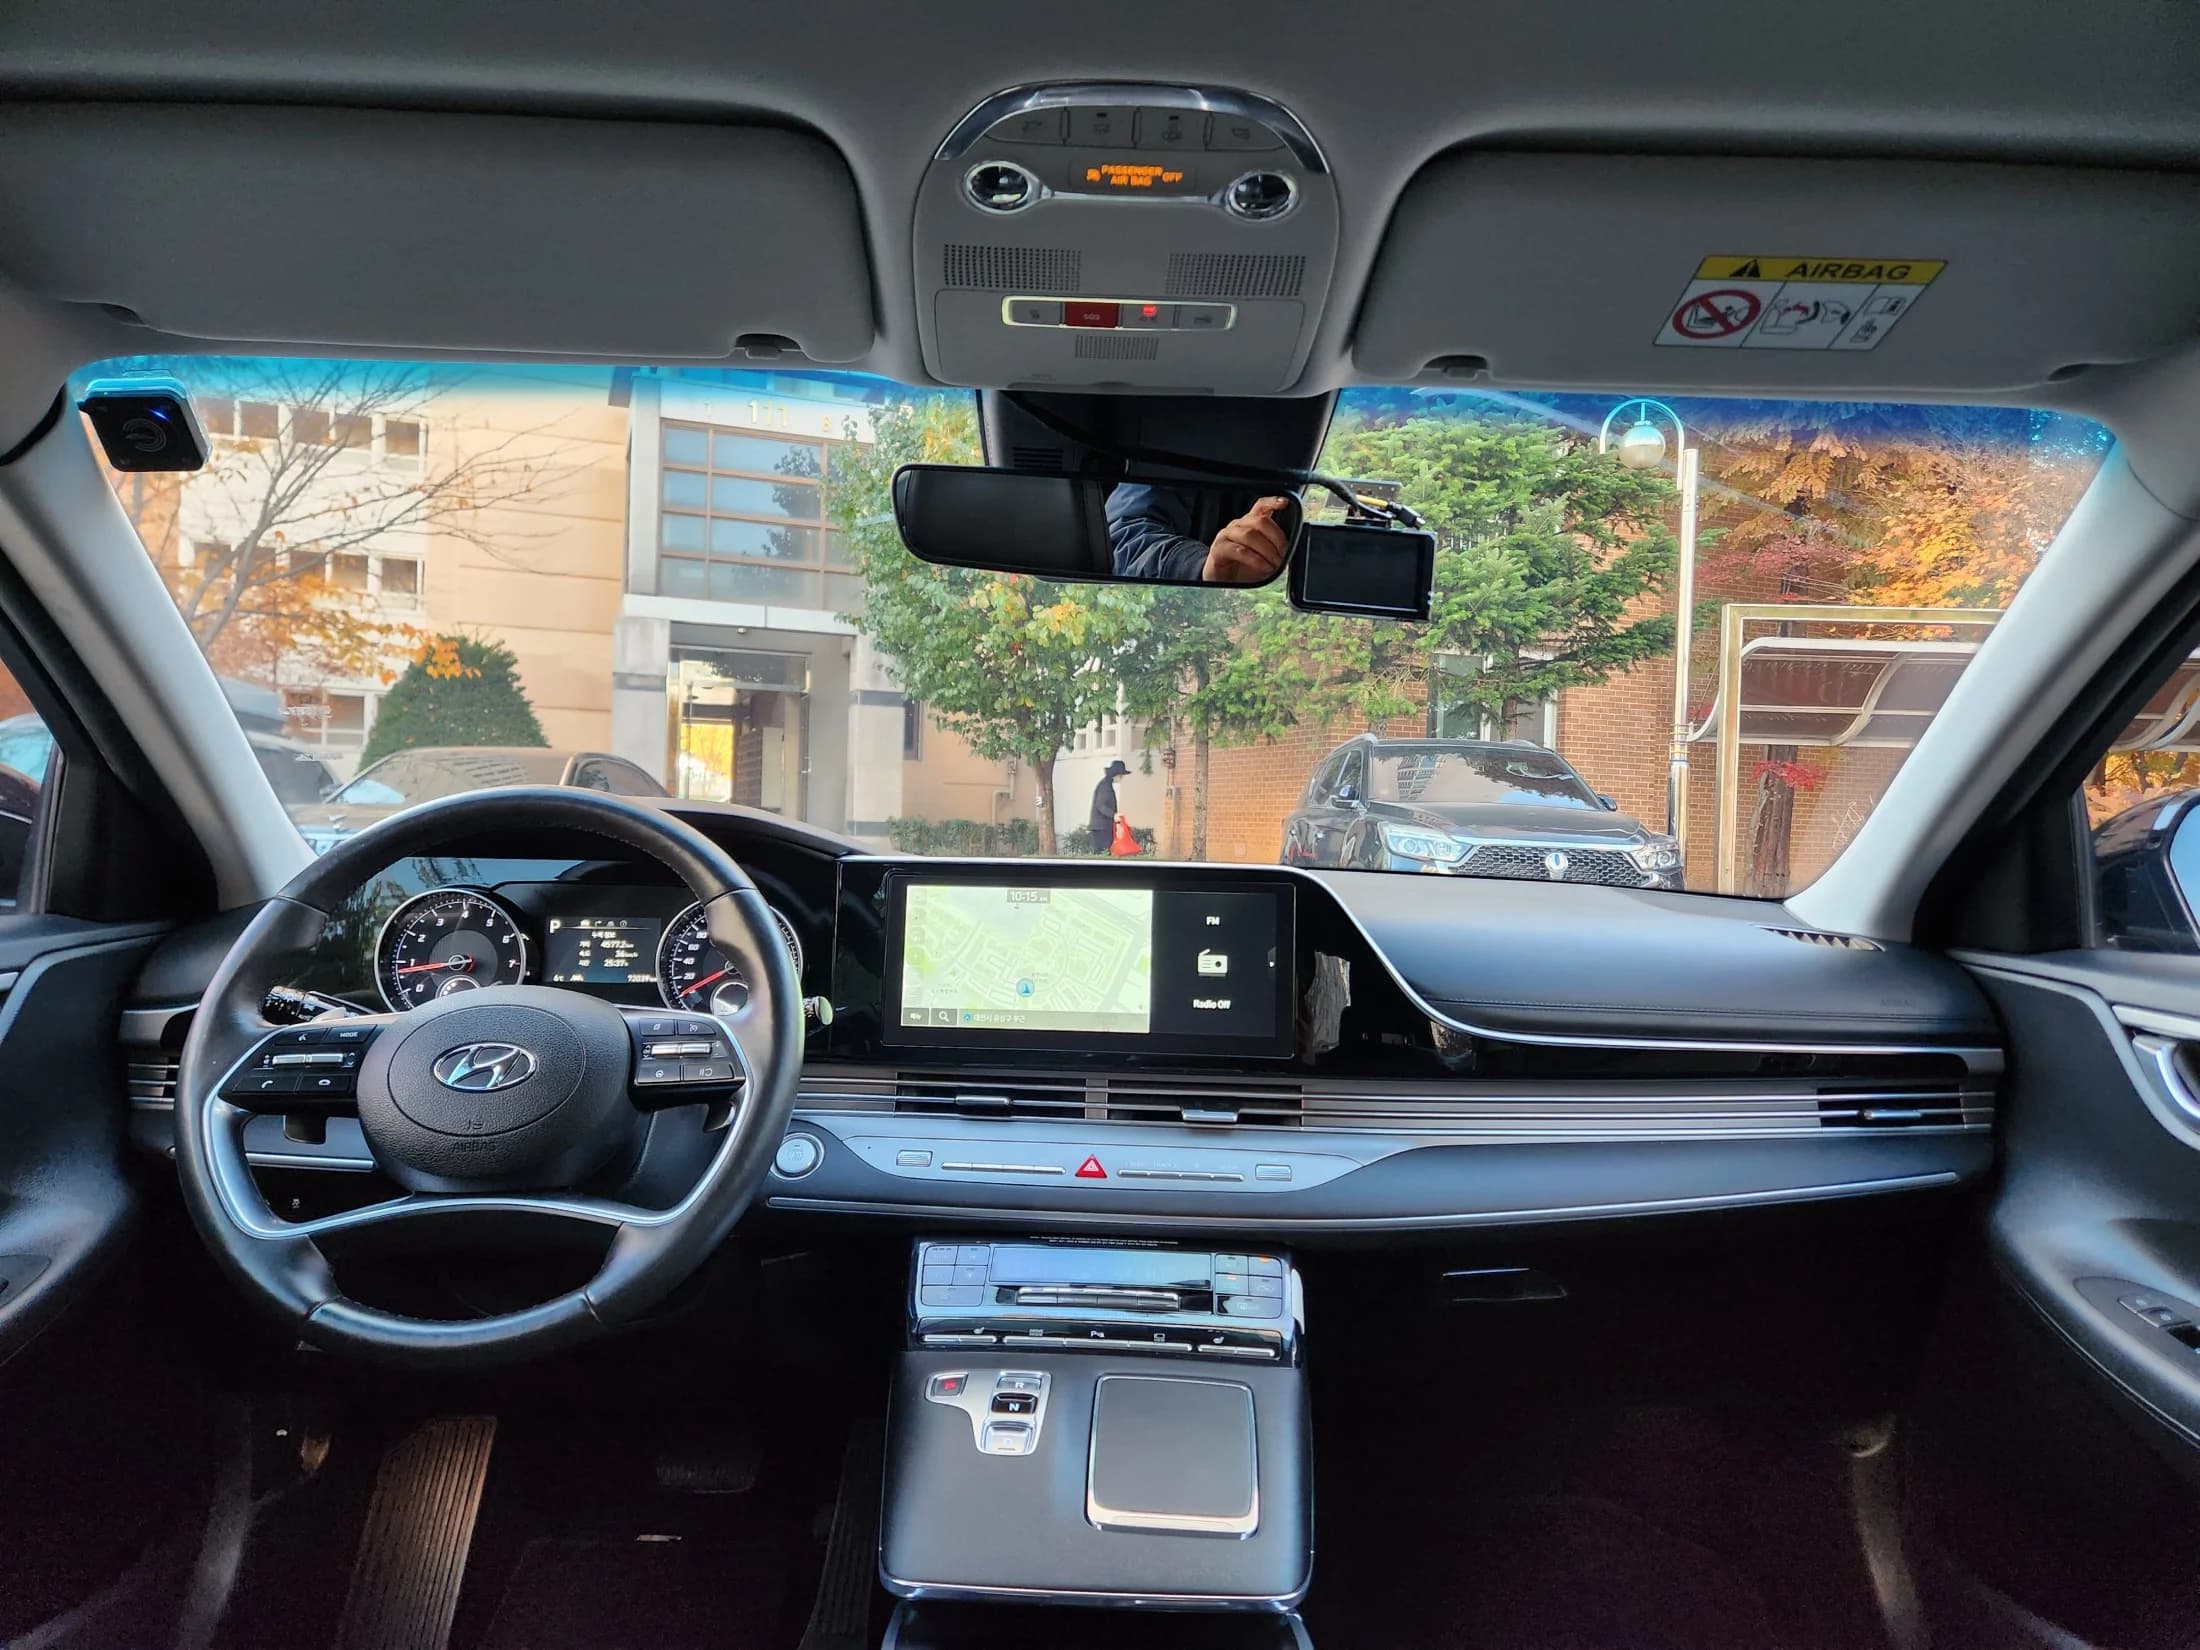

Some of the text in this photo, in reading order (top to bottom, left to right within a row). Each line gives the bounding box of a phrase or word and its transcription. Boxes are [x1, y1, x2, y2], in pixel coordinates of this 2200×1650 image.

[1101, 164, 1163, 176] PASSENGER
[1110, 175, 1152, 186] AIR BAG
[1162, 172, 1183, 183] OFF
[1784, 262, 1912, 280] AIRBAG
[1010, 891, 1038, 902] 10:15
[436, 918, 445, 926] 3
[485, 918, 494, 927] 5
[1206, 916, 1220, 926] FM
[549, 919, 561, 934] P
[417, 934, 426, 943] 2
[502, 935, 510, 944] 6
[687, 943, 700, 951] 60
[682, 957, 695, 965] 40
[683, 972, 695, 980] 20
[415, 983, 424, 993] 0
[1193, 999, 1231, 1010] Radio Off
[944, 1380, 956, 1391] P
[1009, 1402, 1020, 1412] N
